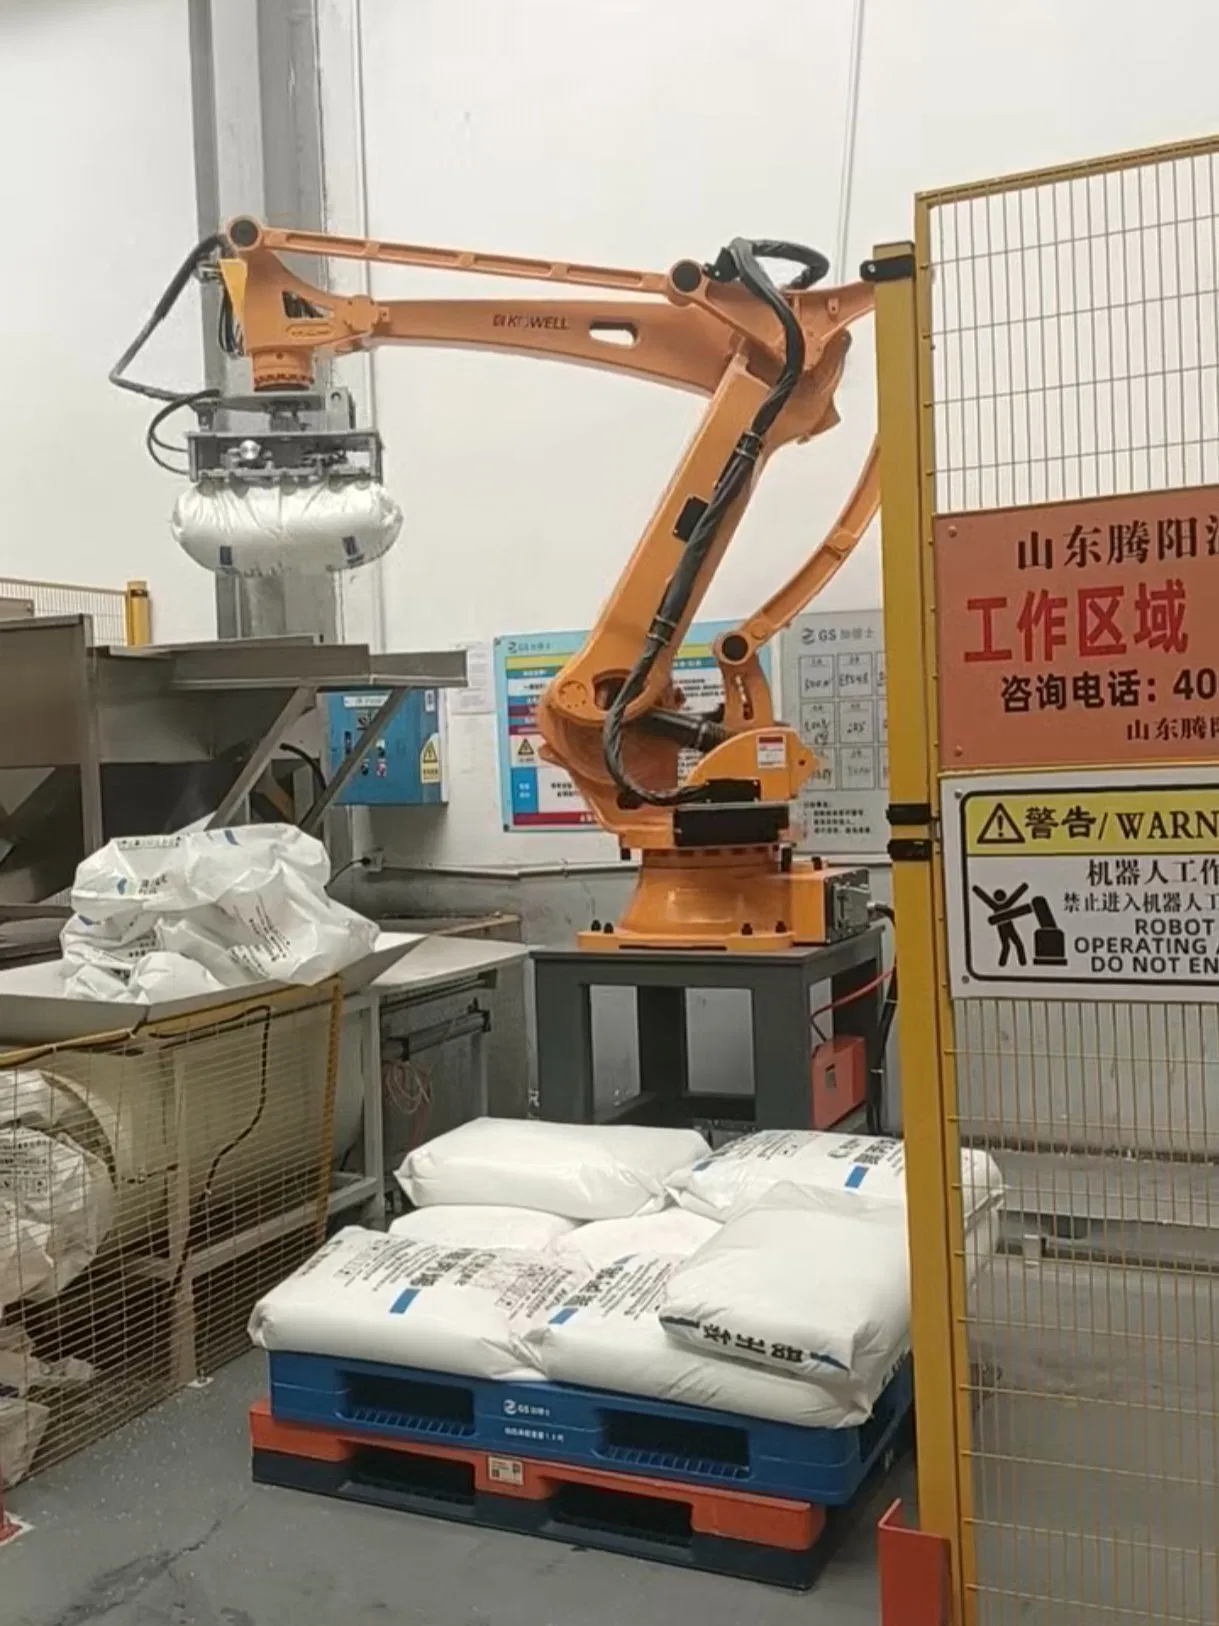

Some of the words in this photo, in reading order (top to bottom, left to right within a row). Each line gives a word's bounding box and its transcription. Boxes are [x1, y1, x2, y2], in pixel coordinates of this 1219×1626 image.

[963, 578, 1189, 663] 工作区域
[1135, 918, 1215, 936] ROBOT
[1074, 937, 1206, 955] OPERATING
[1091, 955, 1123, 973] DO
[1133, 956, 1180, 974] NOT
[1189, 957, 1219, 974] EN
